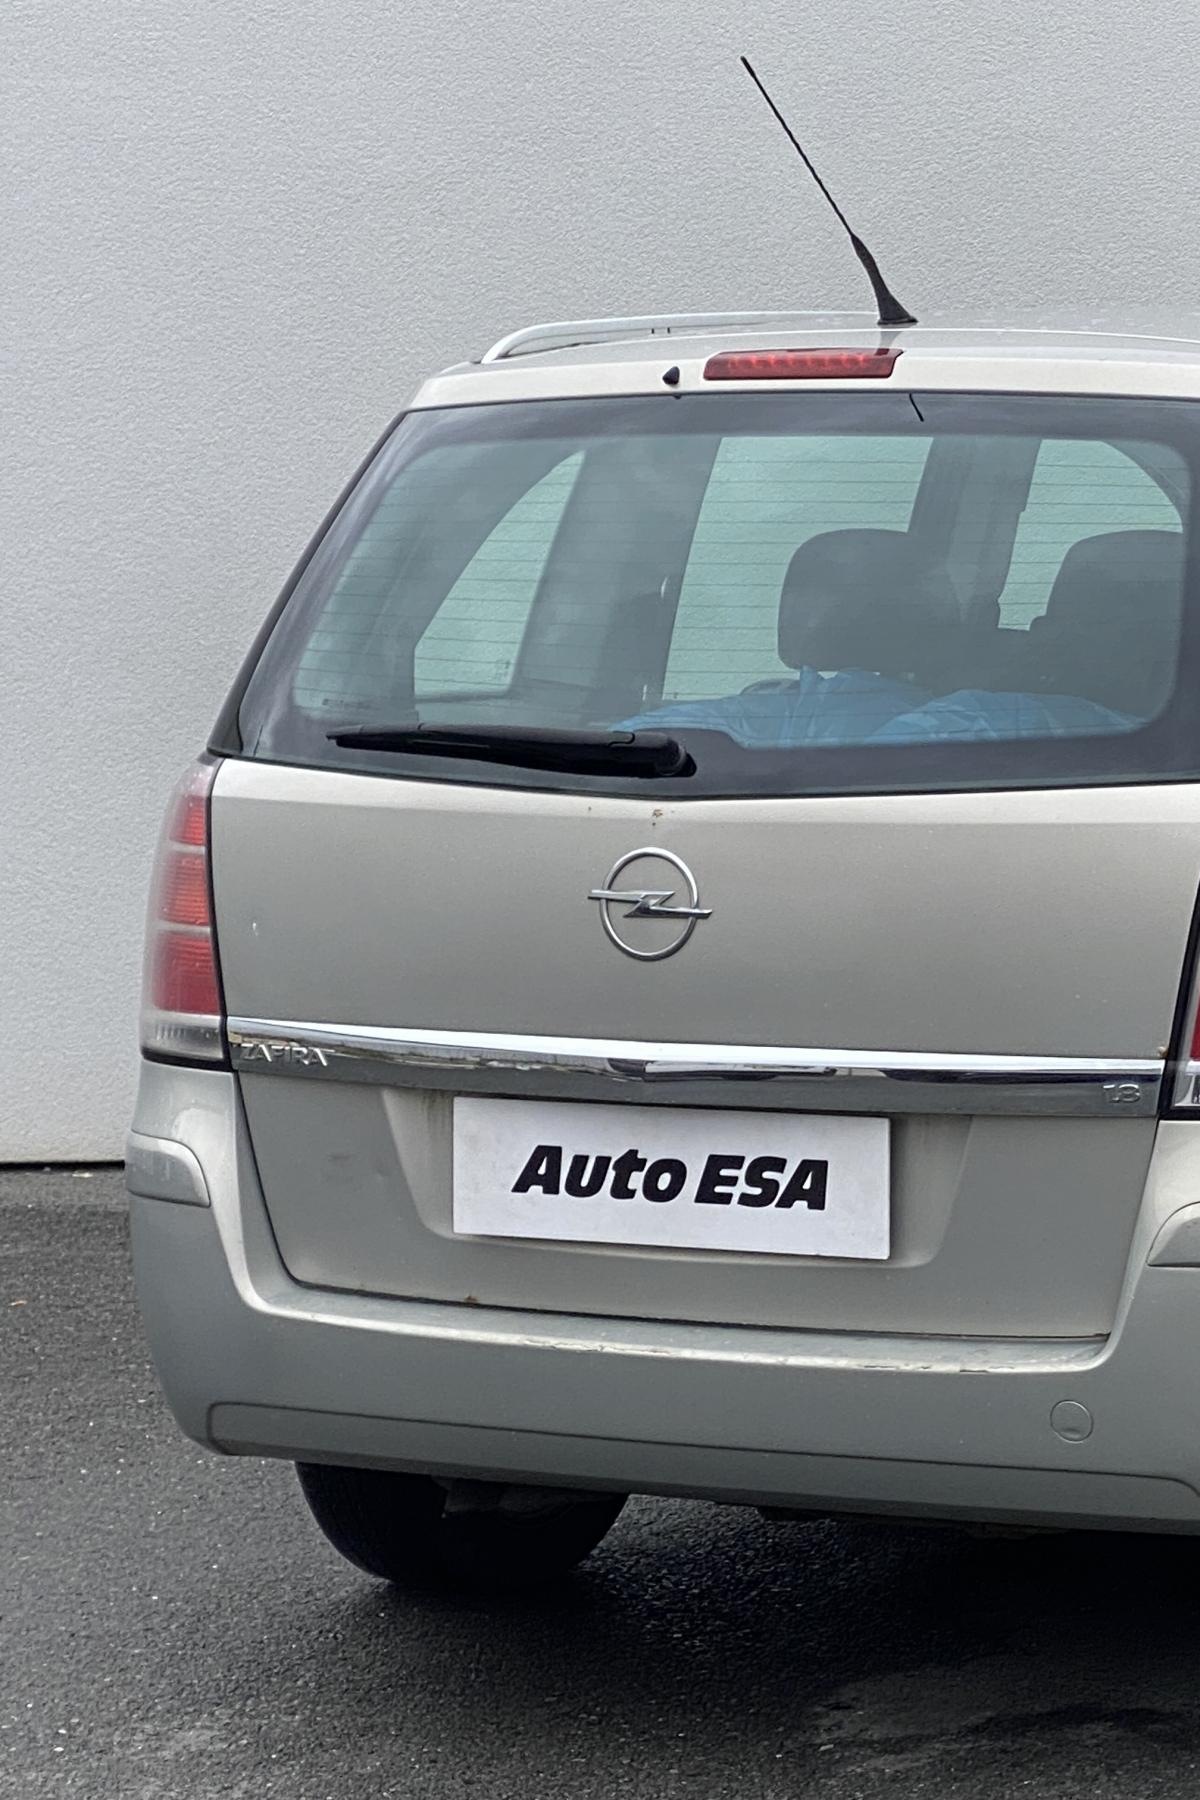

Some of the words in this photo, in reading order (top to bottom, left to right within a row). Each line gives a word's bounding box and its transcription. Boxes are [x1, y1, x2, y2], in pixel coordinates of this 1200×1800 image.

[241, 1044, 328, 1066] ZAFIRA
[511, 1145, 687, 1203] Auto
[694, 1154, 829, 1210] ESA
